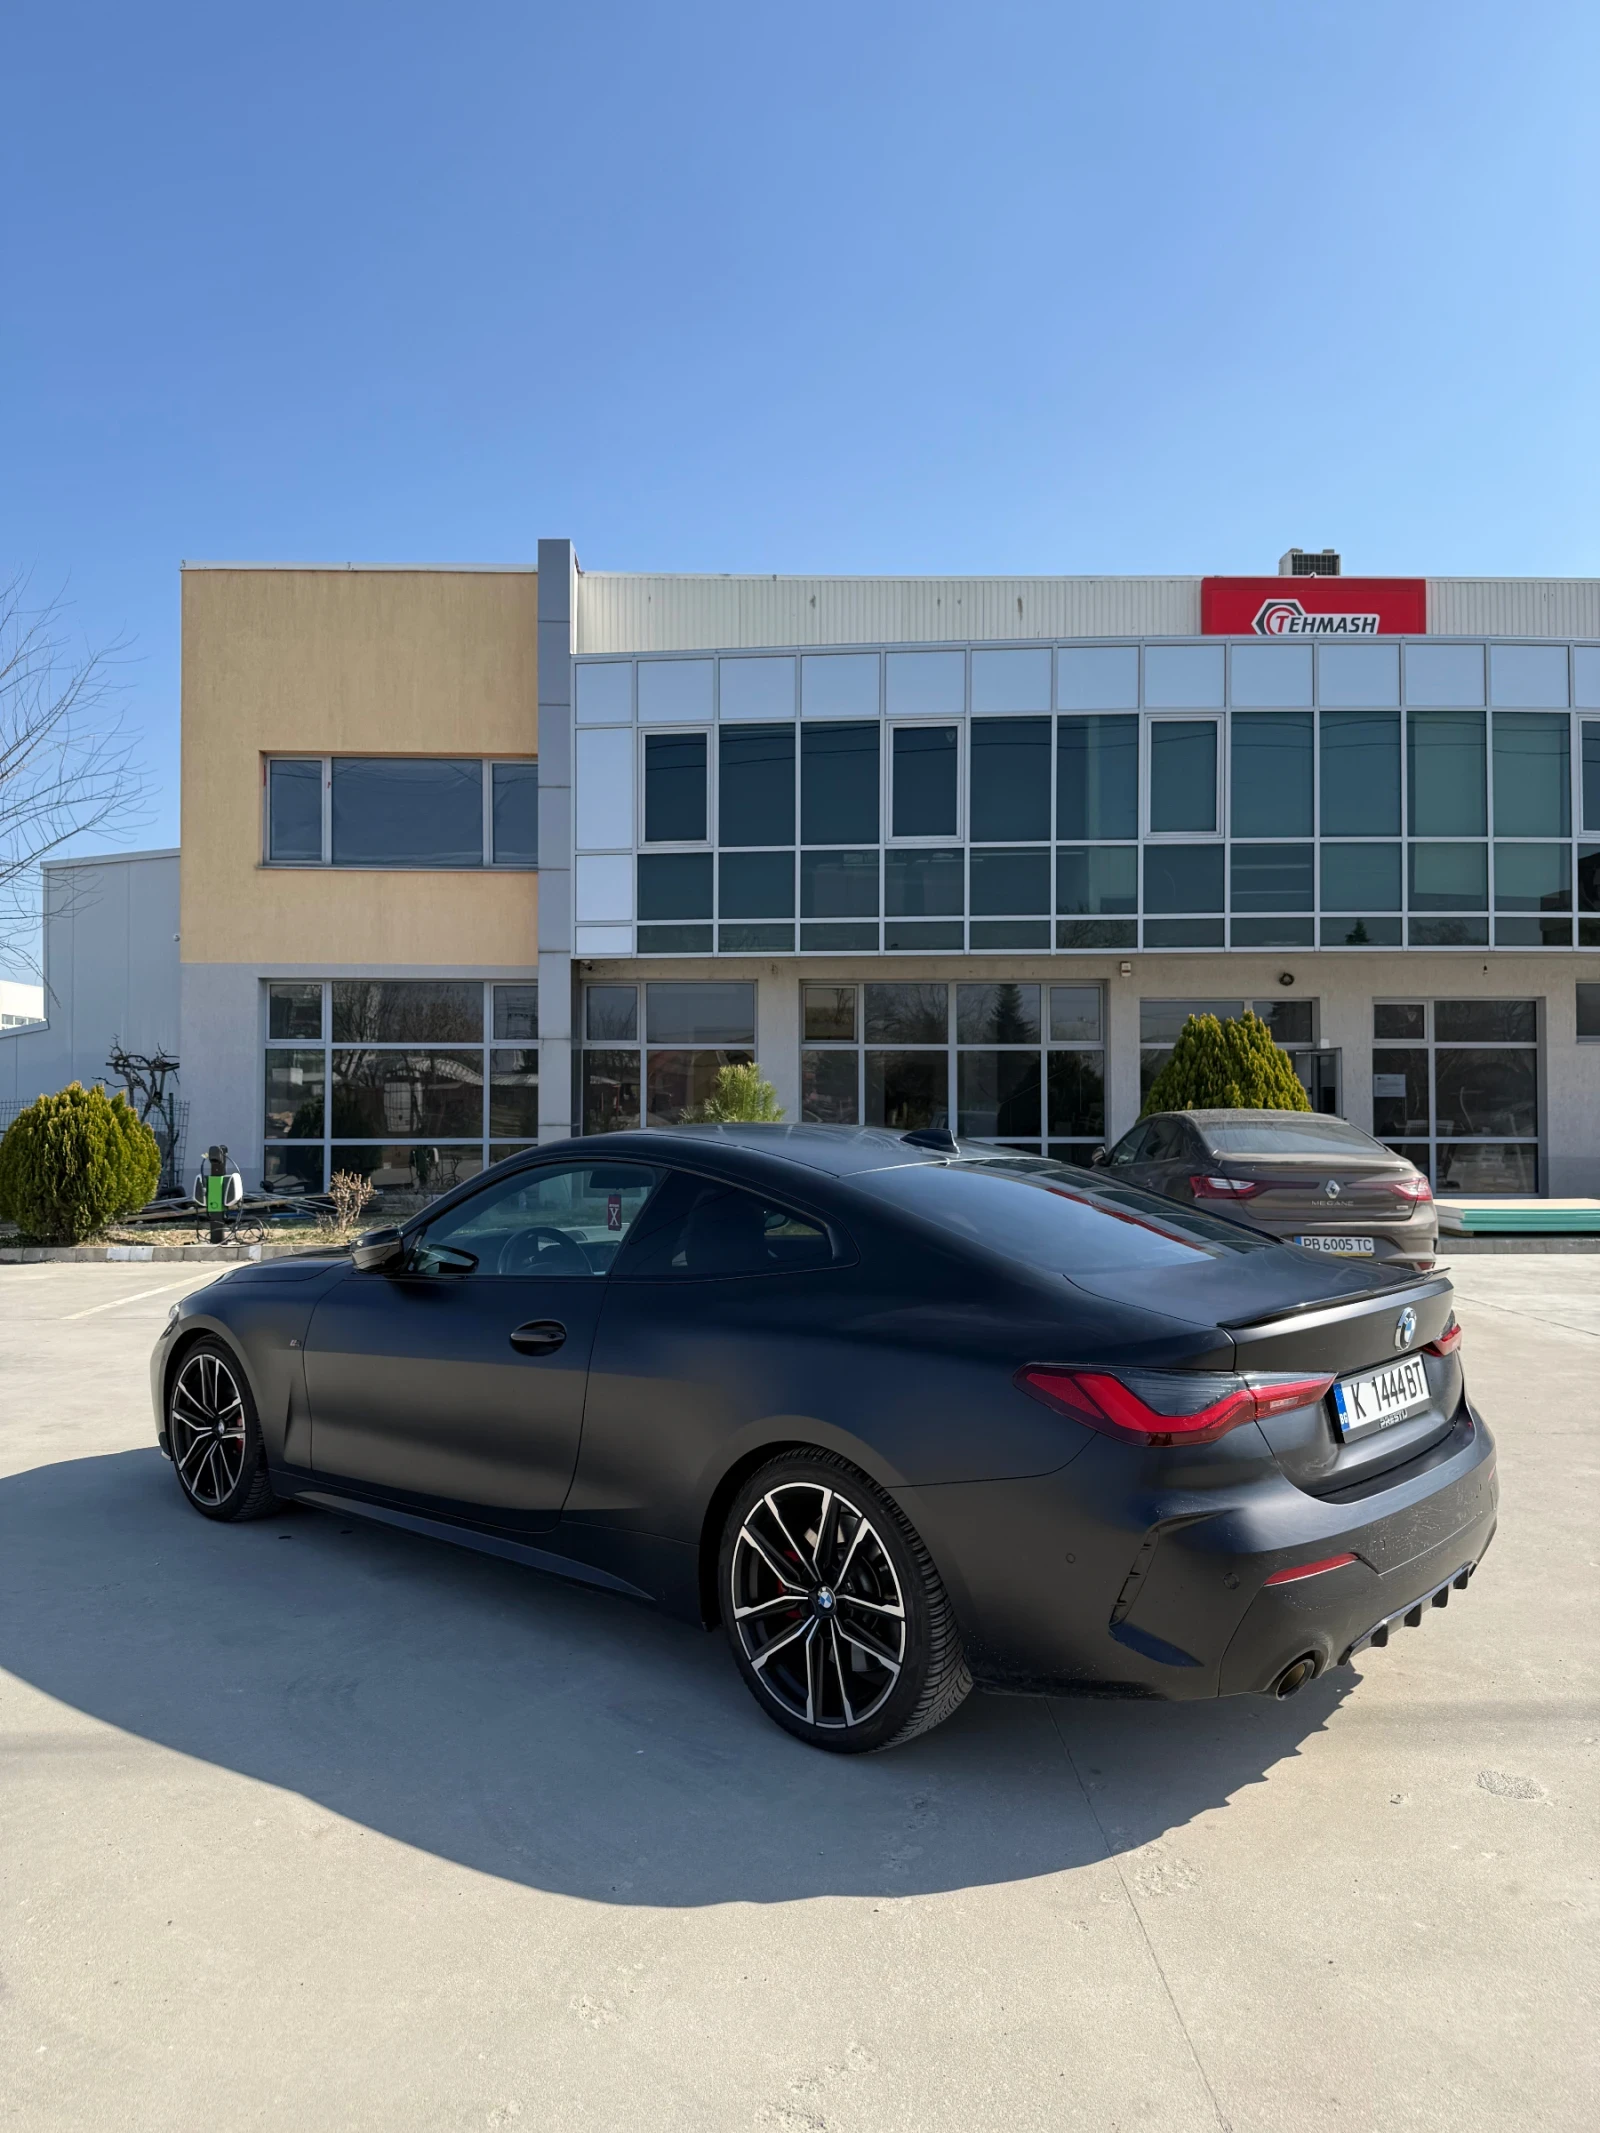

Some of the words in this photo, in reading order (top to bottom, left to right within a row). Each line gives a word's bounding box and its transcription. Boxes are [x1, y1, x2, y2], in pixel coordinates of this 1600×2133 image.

[1276, 615, 1376, 633] TEHMASH
[1303, 1237, 1320, 1251] PB
[1323, 1238, 1353, 1251] 6005
[1354, 1239, 1372, 1251] TC
[1350, 1382, 1367, 1420] K
[1339, 1412, 1348, 1425] BG
